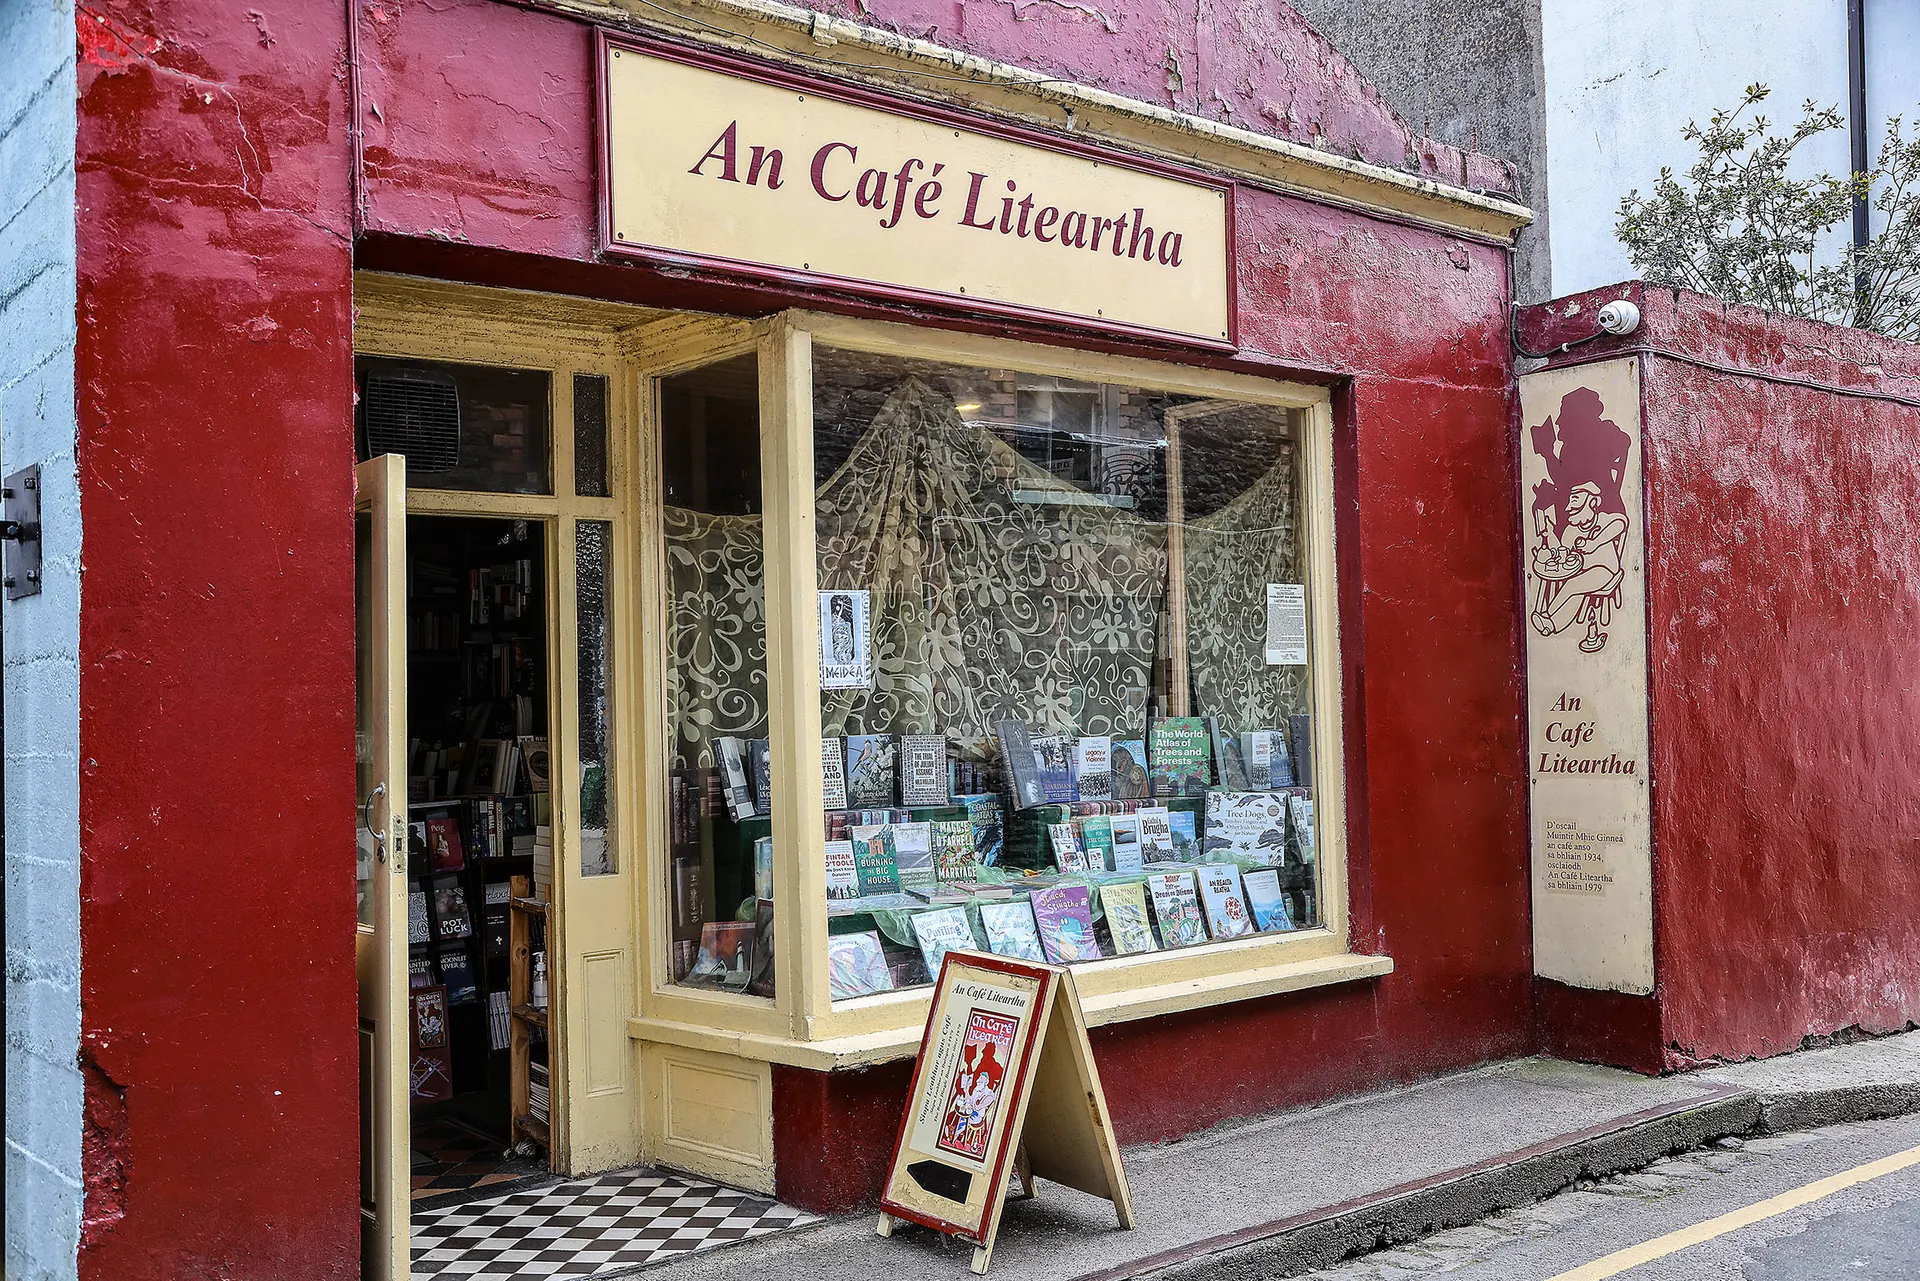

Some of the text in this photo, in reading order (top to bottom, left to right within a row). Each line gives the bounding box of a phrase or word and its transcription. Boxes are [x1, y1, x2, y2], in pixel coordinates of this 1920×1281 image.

[688, 120, 1184, 268] An Café Liteartha
[1550, 691, 1582, 712] An
[1156, 730, 1203, 738] The World
[1545, 721, 1595, 748] Café
[1156, 739, 1191, 747] Atlas of
[1156, 748, 1202, 756] Trees and
[1156, 757, 1193, 765] Forests
[1538, 752, 1636, 775] Liteartha
[972, 802, 997, 811] COASTAL
[1226, 810, 1267, 819] Tree Dogs,
[1142, 819, 1169, 836] Brugha
[1547, 821, 1577, 830] D'oscail
[937, 835, 974, 847] O'FARRELL
[1547, 831, 1573, 840] Muintir
[1575, 832, 1595, 841] Mhic
[1557, 842, 1572, 850] café
[861, 857, 893, 867] BURNING
[1557, 852, 1581, 860] bhliain
[1584, 853, 1604, 862] 1934,
[876, 867, 889, 875] BIG
[939, 867, 977, 879] MARRIAGE
[867, 876, 891, 884] HOUSE
[1560, 871, 1577, 880] Café
[1580, 873, 1613, 882] Liteartha
[1557, 881, 1582, 890] bhliain
[1585, 883, 1602, 891] 1979
[443, 918, 462, 928] POT
[440, 925, 468, 935] LUCK
[952, 984, 1025, 1007] An Café Liteartha
[942, 1014, 952, 1036] Café
[972, 1015, 986, 1029] An
